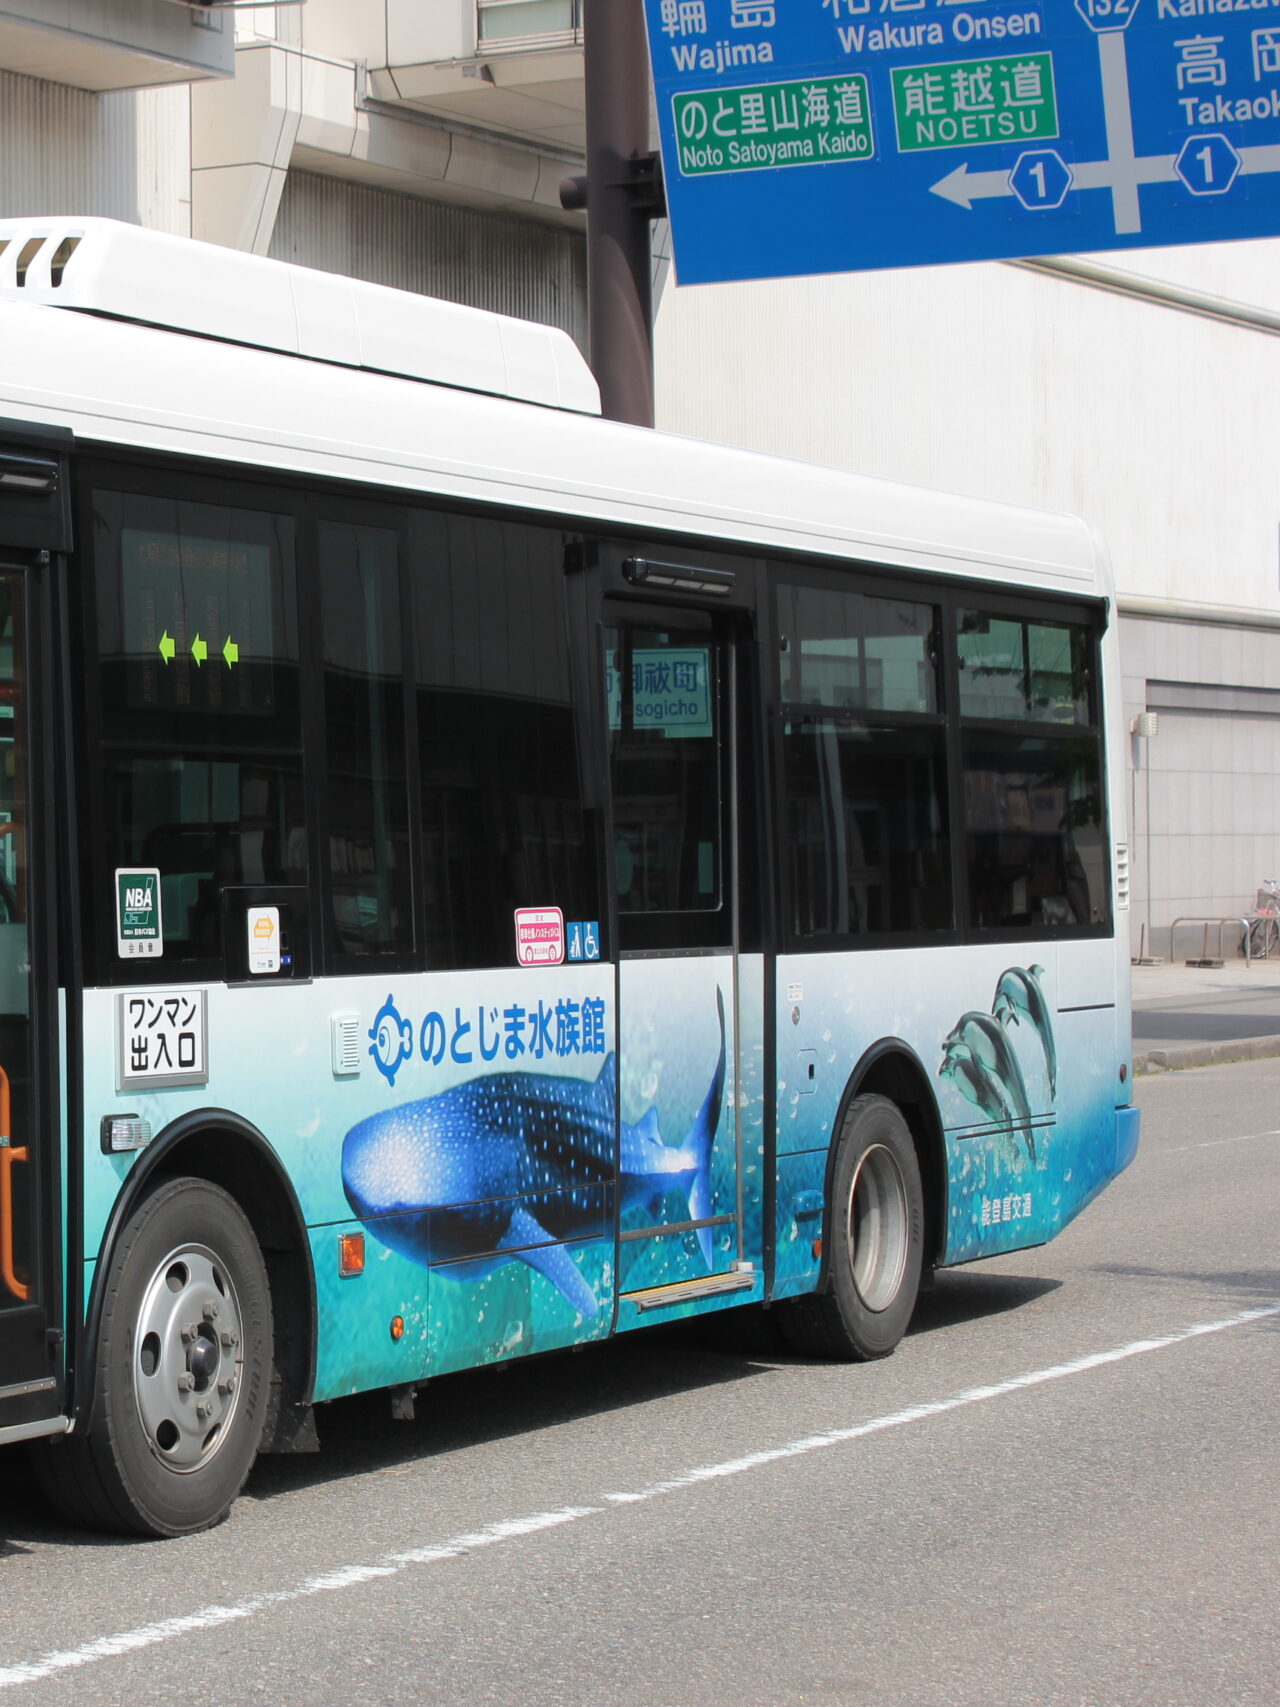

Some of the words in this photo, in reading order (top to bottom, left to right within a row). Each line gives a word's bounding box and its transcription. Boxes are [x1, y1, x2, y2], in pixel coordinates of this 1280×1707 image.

[837, 22, 944, 54] Wakura
[952, 12, 1041, 42] Onsen
[671, 41, 774, 73] Wajima
[903, 61, 1044, 117] 能越道
[681, 81, 864, 140] のと里山海道
[916, 109, 1037, 143] NOETSU
[683, 146, 723, 169] Noto
[729, 139, 814, 165] Satoyama
[818, 130, 868, 156] Kaido
[1196, 147, 1213, 183] 1
[1029, 162, 1046, 198] 1
[125, 888, 152, 907] NBA
[129, 997, 197, 1029] ワンマン
[420, 996, 605, 1066] のとじま水族館
[131, 1032, 195, 1071] 出入口
[982, 1192, 1032, 1226] 能登島交通
